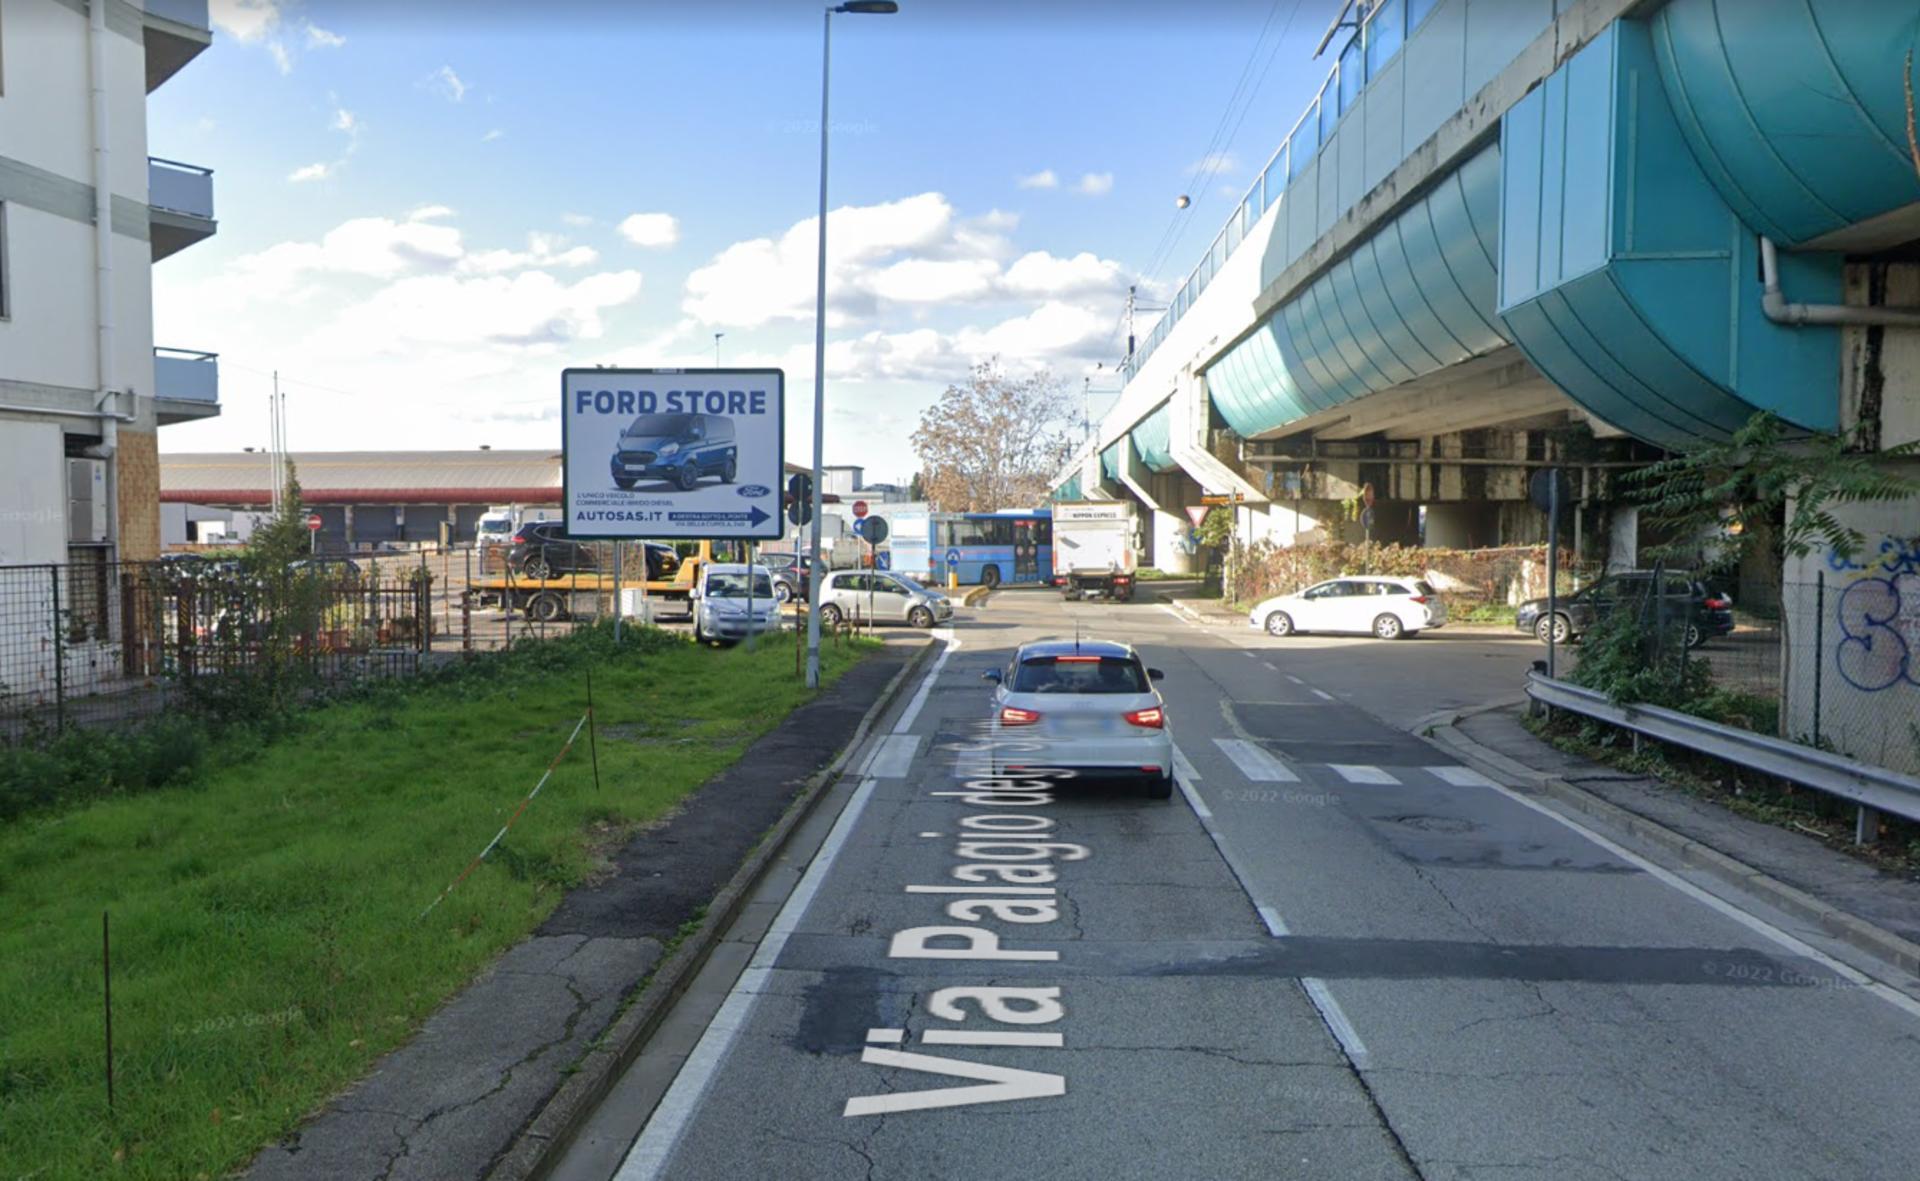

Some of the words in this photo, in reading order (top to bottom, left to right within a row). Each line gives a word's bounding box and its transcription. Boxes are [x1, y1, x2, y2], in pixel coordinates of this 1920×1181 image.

[576, 390, 658, 415] FORD
[665, 390, 767, 415] STORE
[577, 511, 663, 521] AUTOSAS.IT
